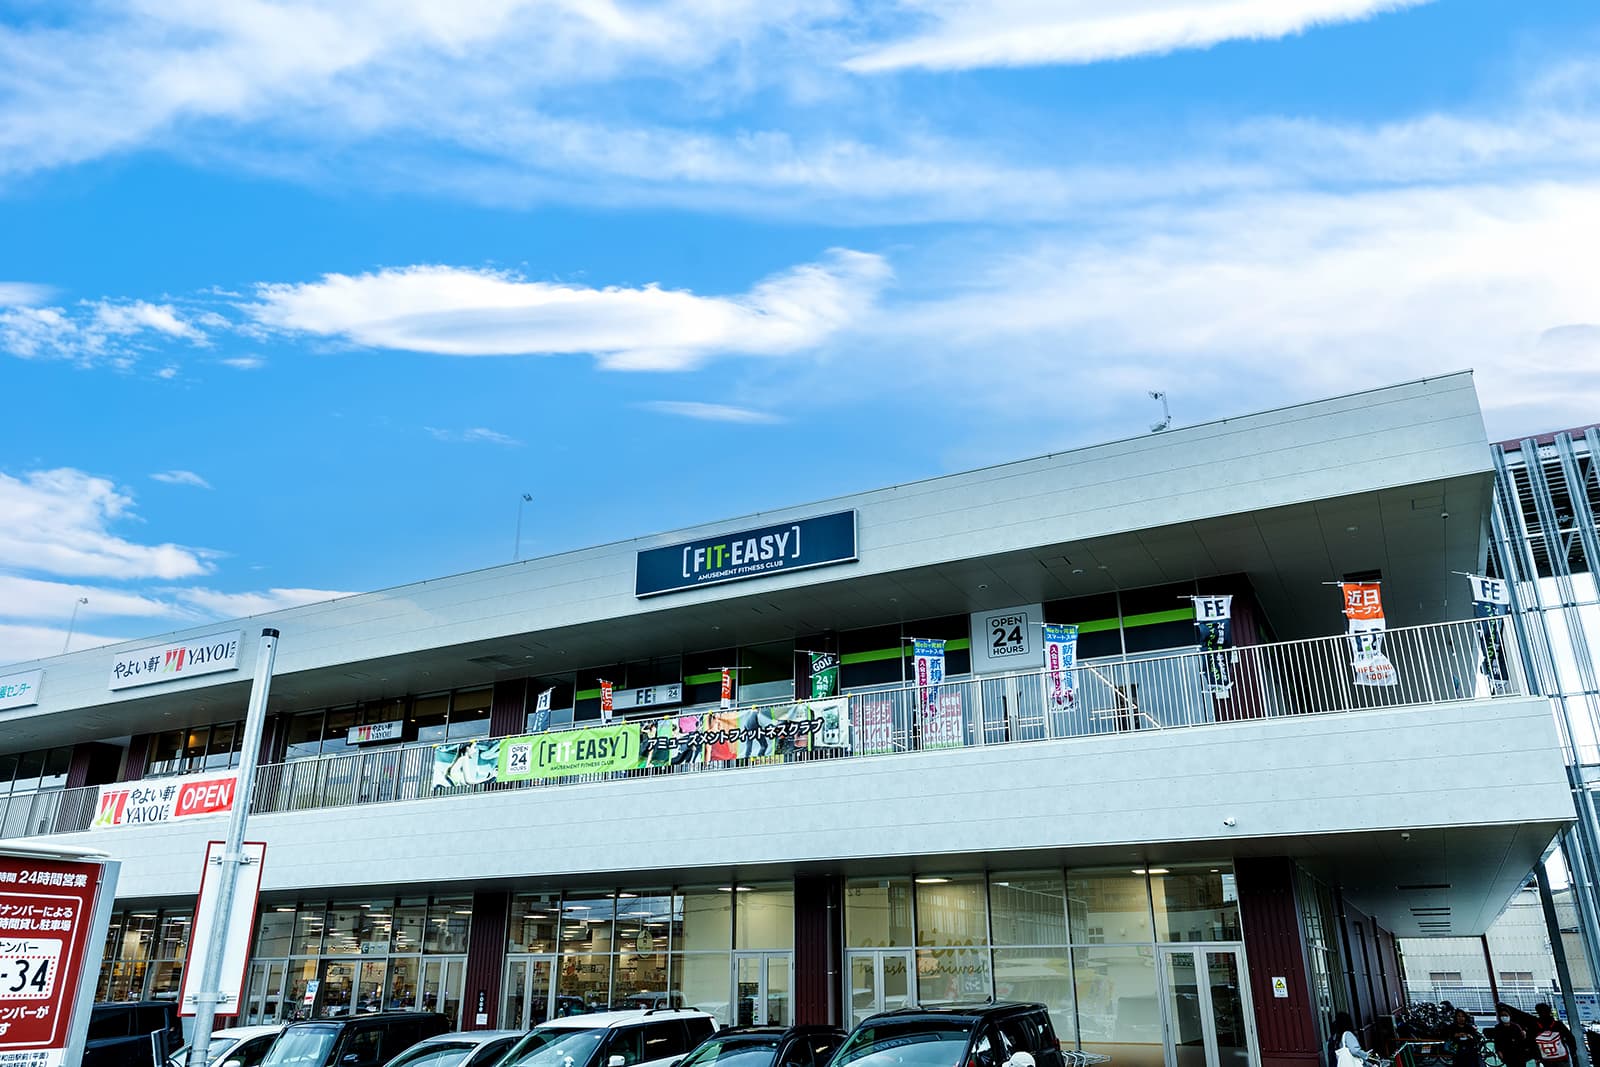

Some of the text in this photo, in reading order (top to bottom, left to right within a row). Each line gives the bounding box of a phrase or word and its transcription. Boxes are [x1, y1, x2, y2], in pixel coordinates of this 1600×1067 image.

[698, 559, 784, 581] AMUSEMENT FITNESS CLUB
[1347, 589, 1379, 607] 近日
[1481, 580, 1500, 600] FE
[1204, 599, 1225, 618] FE
[1346, 606, 1381, 615] オープン
[991, 615, 1022, 628] OPEN
[992, 626, 1023, 648] 24
[992, 645, 1024, 656] HOURS
[114, 655, 161, 679] やよい軒
[188, 641, 230, 666] YAYOI
[636, 689, 652, 705] FE
[647, 718, 823, 750] アミューズメントフィットネスクラブ
[511, 746, 529, 754] OPEN
[511, 752, 528, 767] 24
[130, 784, 176, 805] やよい軒
[182, 783, 231, 810] OPEN
[126, 804, 164, 823] YAYOI
[18, 870, 88, 888] 24時間営業
[0, 904, 73, 918] ナンバーによる
[0, 1052, 49, 1061] 和田駅前(平面)
